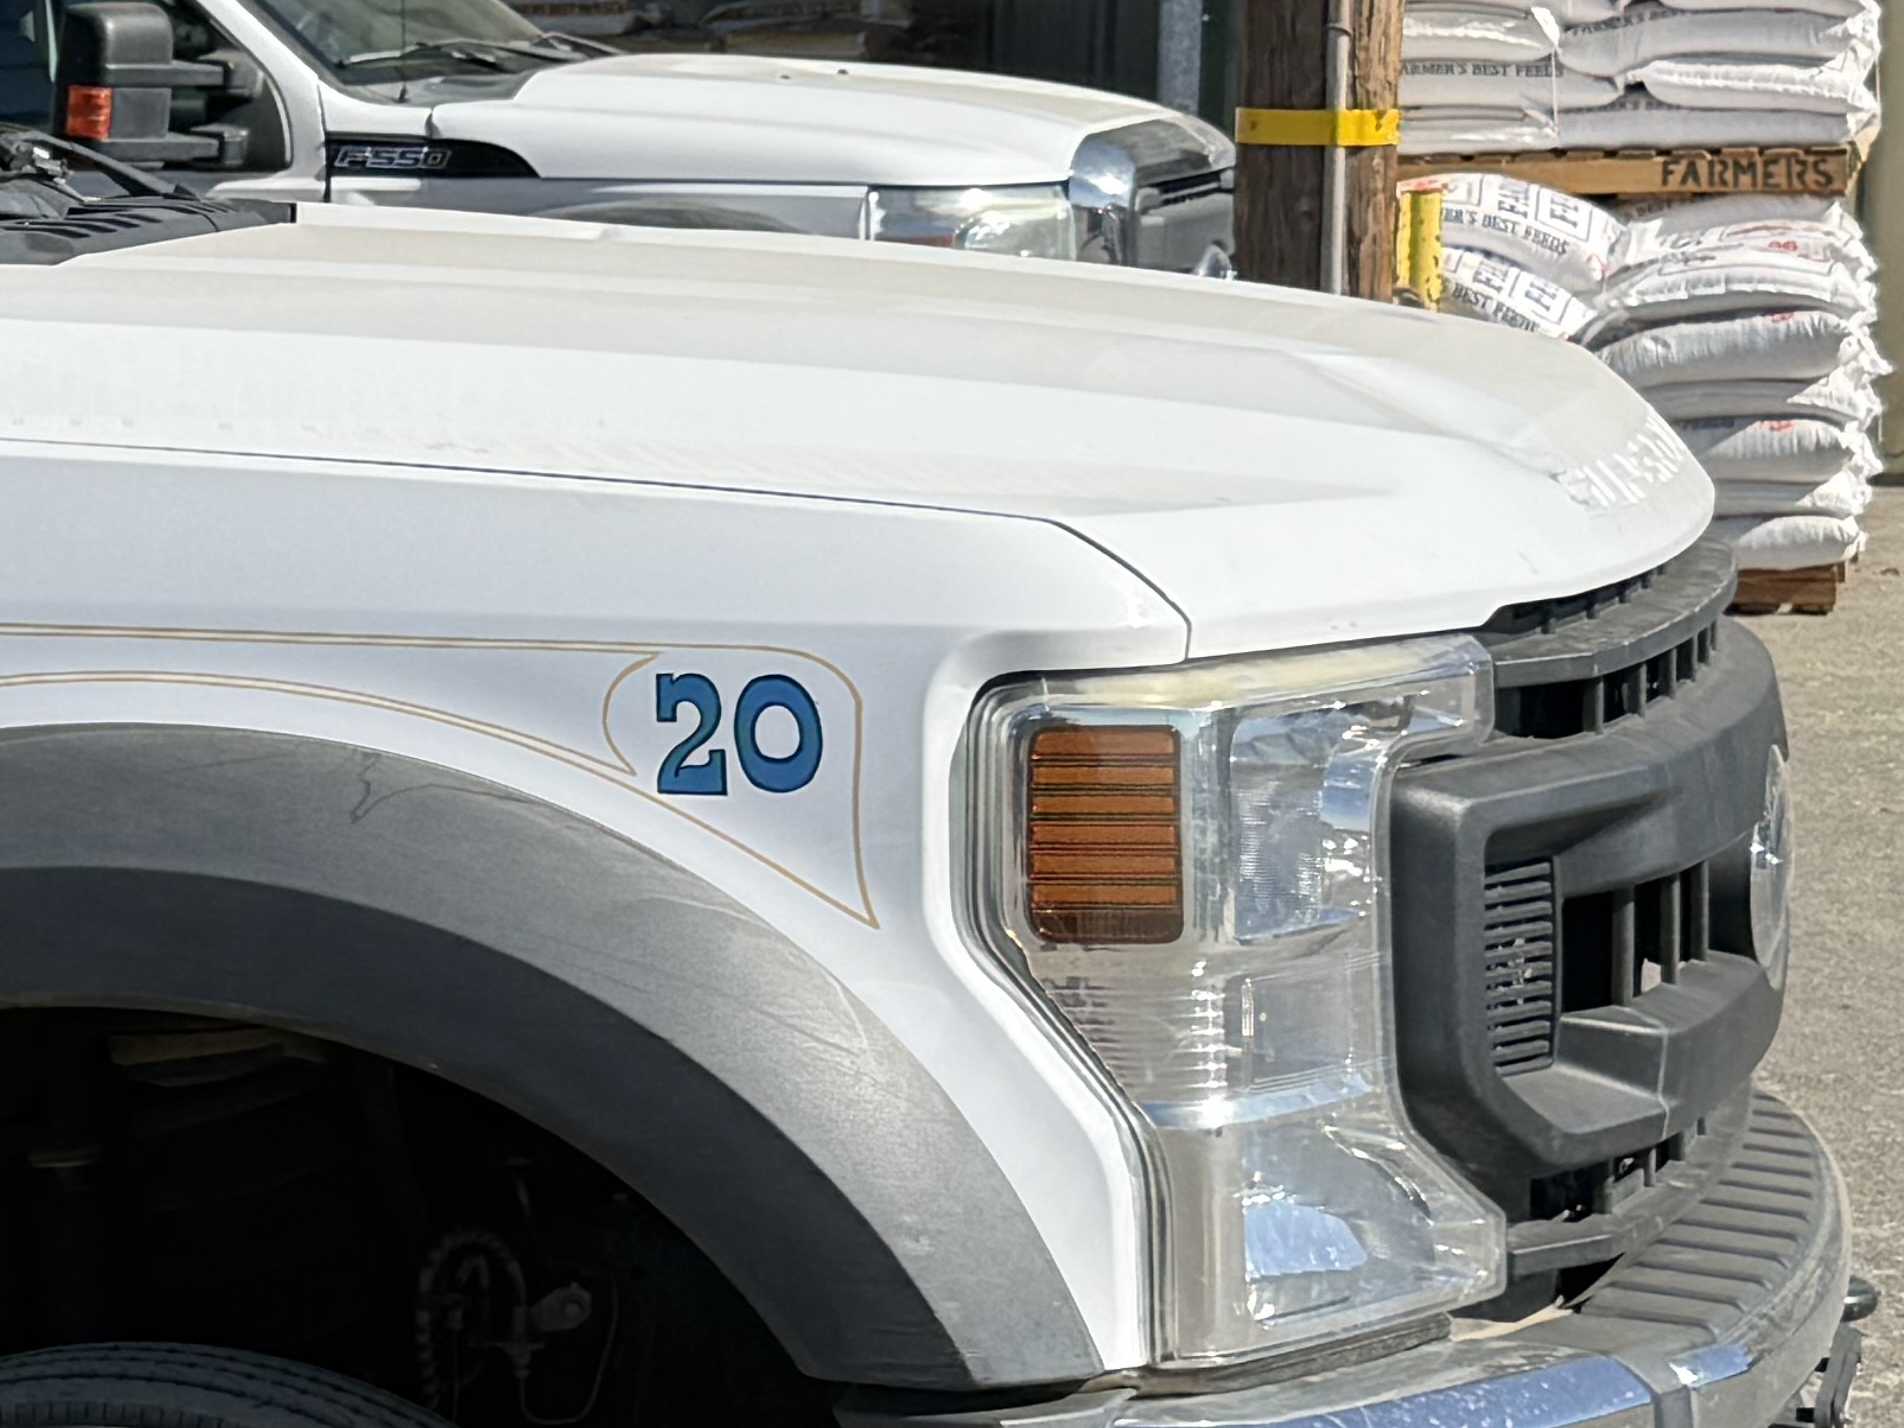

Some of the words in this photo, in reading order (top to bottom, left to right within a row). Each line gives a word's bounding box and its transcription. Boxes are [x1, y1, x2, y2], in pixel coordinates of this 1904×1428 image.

[1401, 62, 1469, 76] ARMER'S
[1472, 63, 1512, 77] BEST
[1661, 157, 1835, 189] FARMERS
[1482, 213, 1522, 235] BEST
[1523, 224, 1570, 257] FEEDS
[655, 673, 823, 796] 20
